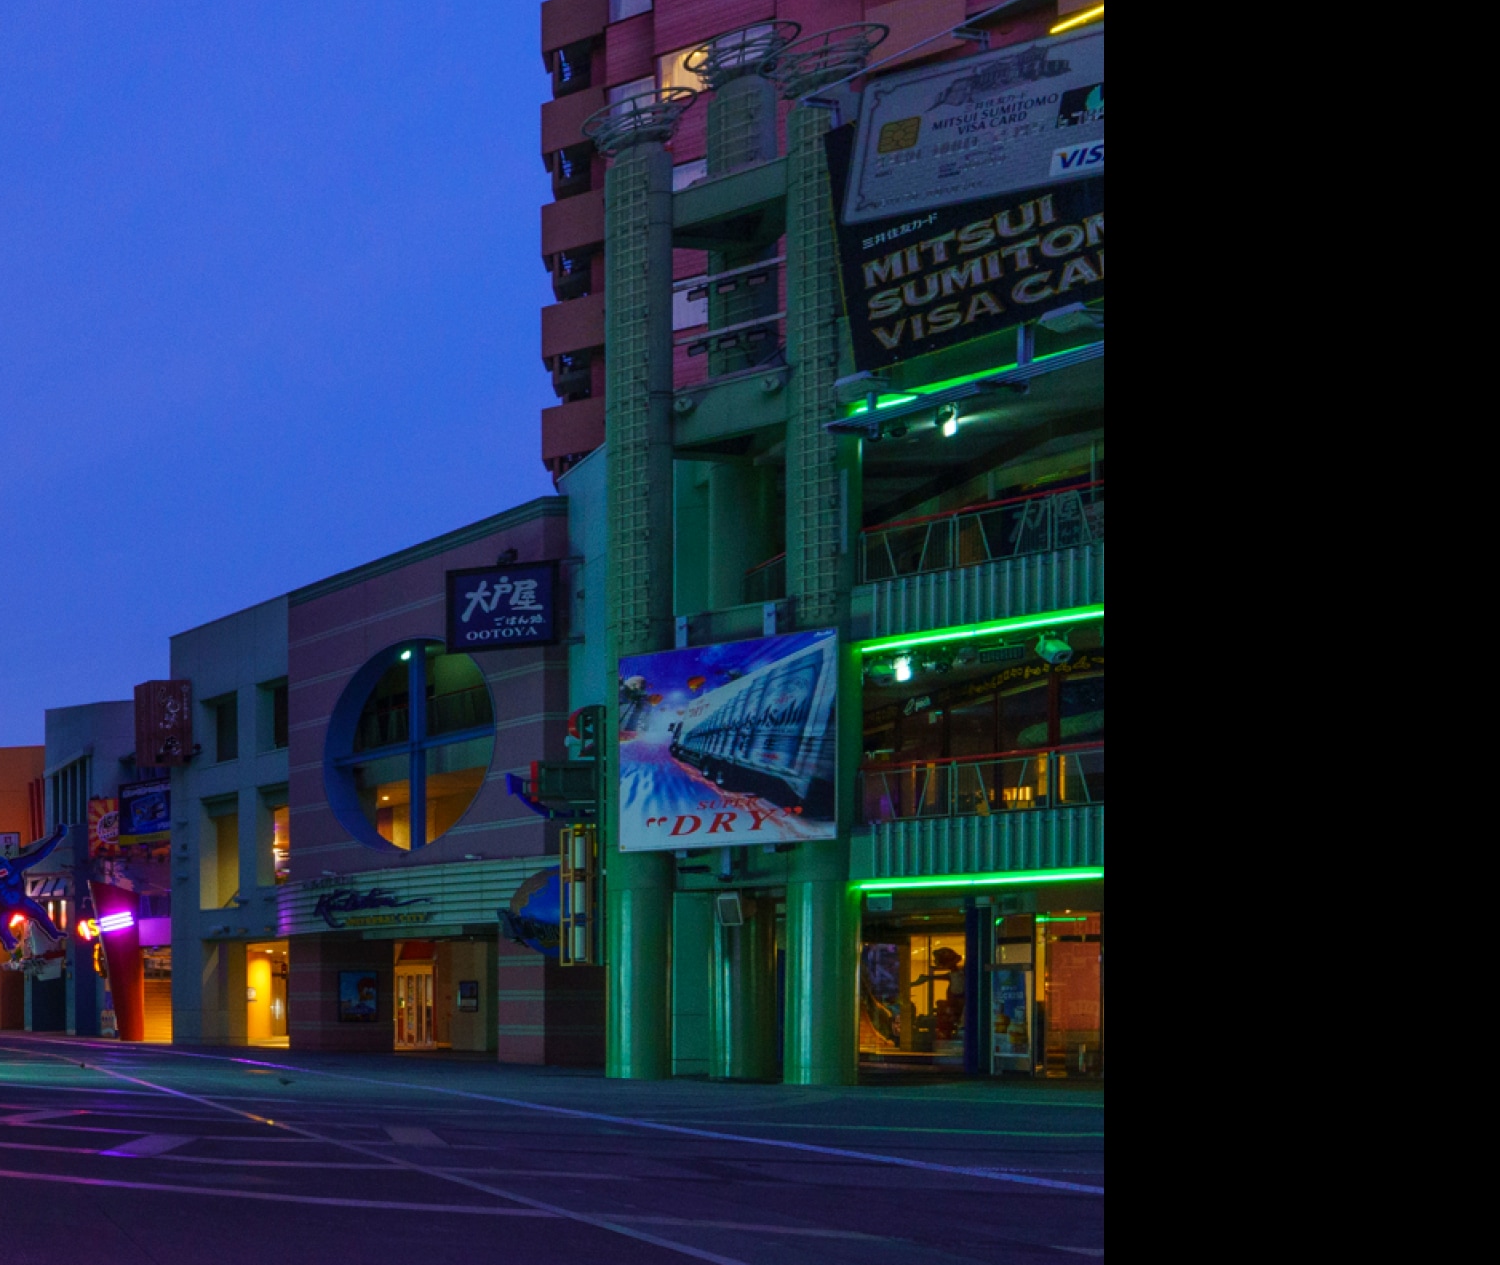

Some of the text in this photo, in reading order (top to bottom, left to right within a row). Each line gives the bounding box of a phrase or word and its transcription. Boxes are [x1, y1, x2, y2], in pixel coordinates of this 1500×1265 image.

[931, 111, 980, 131] MITSUI
[981, 93, 1059, 120] SUMITOMO
[958, 111, 1028, 136] VISA CARD
[1058, 144, 1104, 169] VIS
[863, 193, 1056, 289] MITSUI
[872, 249, 1104, 350] VISA CA
[461, 576, 544, 623] 大戸屋
[466, 626, 538, 641] OOTOYA
[697, 797, 758, 810] SUPER
